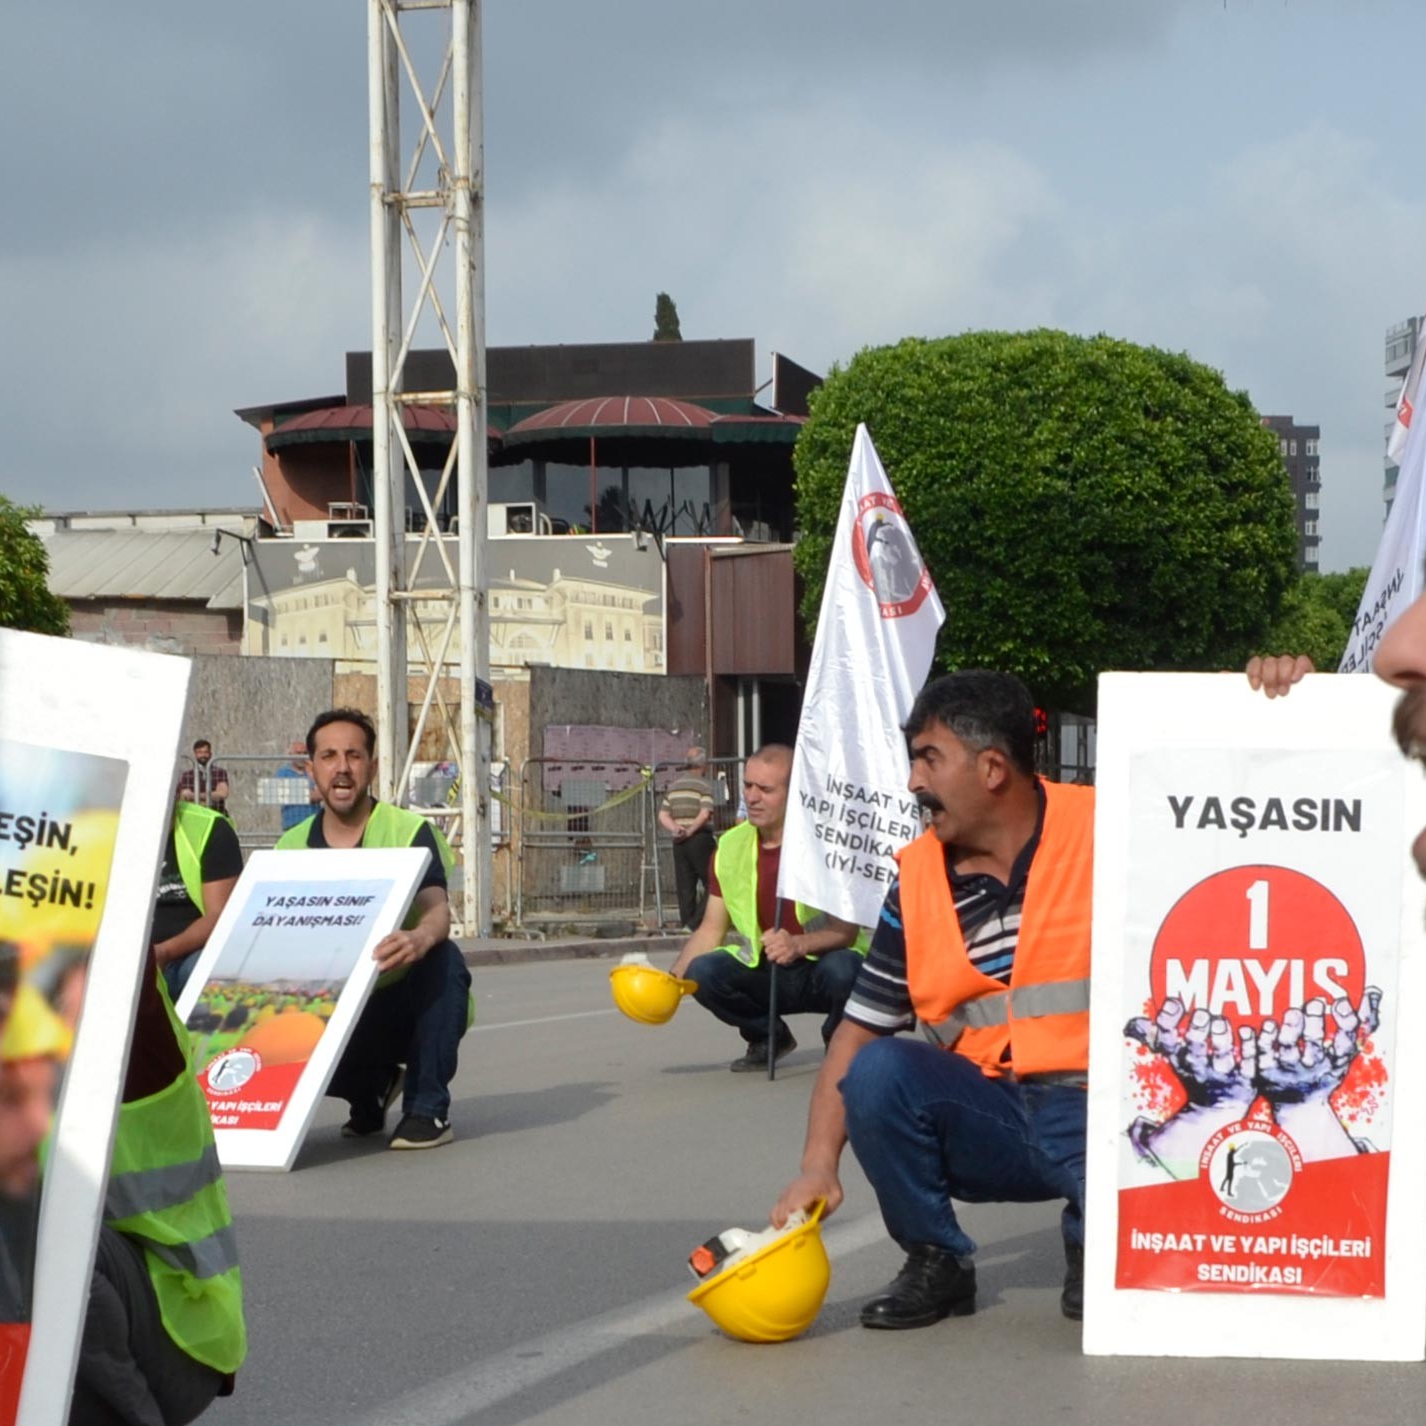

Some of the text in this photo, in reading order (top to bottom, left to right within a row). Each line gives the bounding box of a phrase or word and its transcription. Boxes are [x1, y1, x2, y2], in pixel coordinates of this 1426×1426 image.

[799, 789, 835, 818] YAPI
[826, 773, 919, 821] İNŞAAT VE
[1167, 795, 1363, 838] YAŞASIN
[815, 822, 894, 858] SENDİKA
[825, 850, 898, 884] (İYİ-SEN
[266, 896, 334, 909] YAŞASIN
[1246, 879, 1269, 950] 1
[1166, 957, 1349, 1017] MAYIS
[1131, 1228, 1372, 1259] İNŞAAT VE YAPI İŞÇİLERİ
[1197, 1261, 1303, 1284] SENDİKASI
